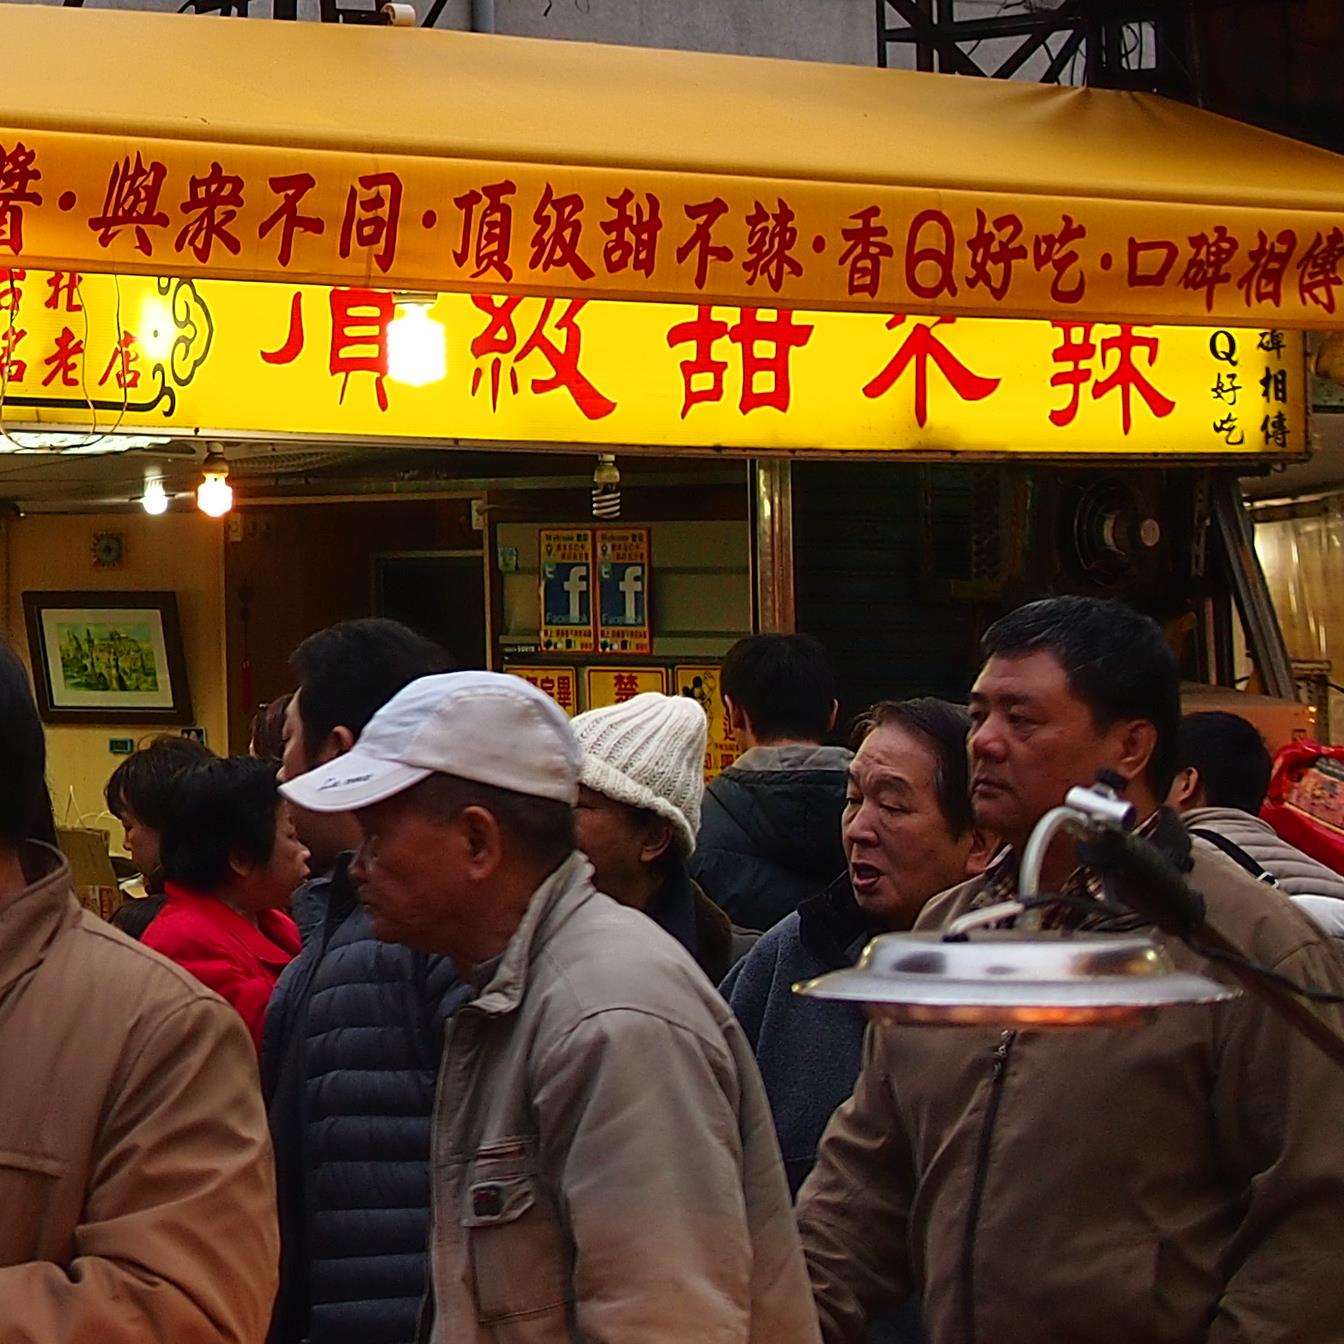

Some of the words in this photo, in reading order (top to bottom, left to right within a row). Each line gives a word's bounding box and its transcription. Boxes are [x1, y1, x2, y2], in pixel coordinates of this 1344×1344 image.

[259, 285, 1178, 432] 頂級甜不辣
[1209, 329, 1245, 446] Q好吃
